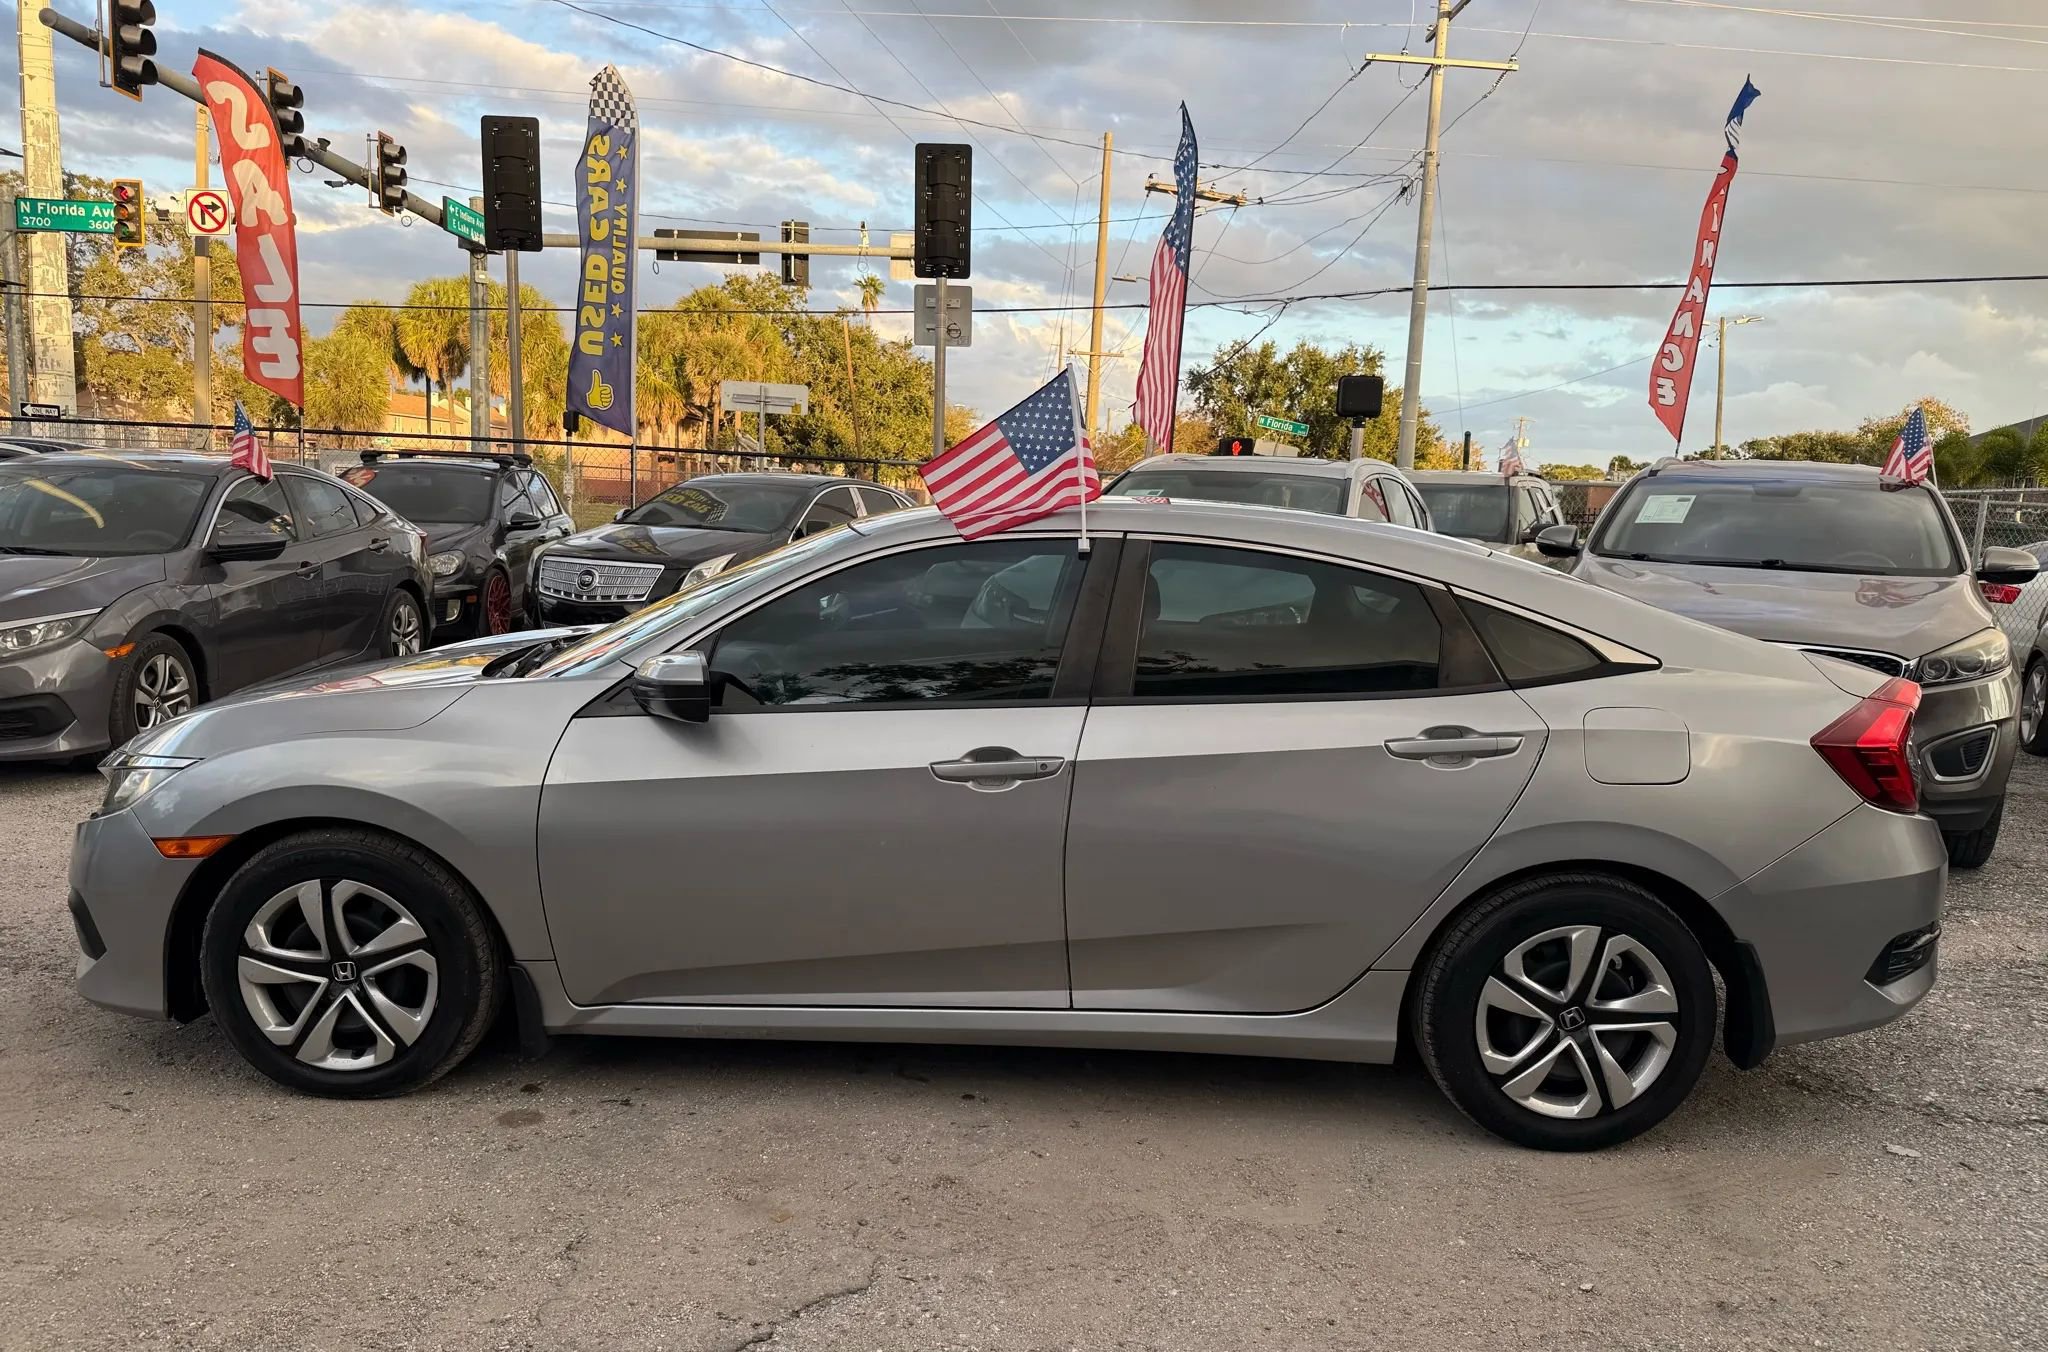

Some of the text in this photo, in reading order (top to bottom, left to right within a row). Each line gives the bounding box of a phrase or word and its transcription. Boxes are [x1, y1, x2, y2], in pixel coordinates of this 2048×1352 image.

[20, 201, 30, 213] N
[37, 202, 86, 216] Florida
[22, 216, 51, 227] 3700
[1266, 417, 1293, 431] Florida
